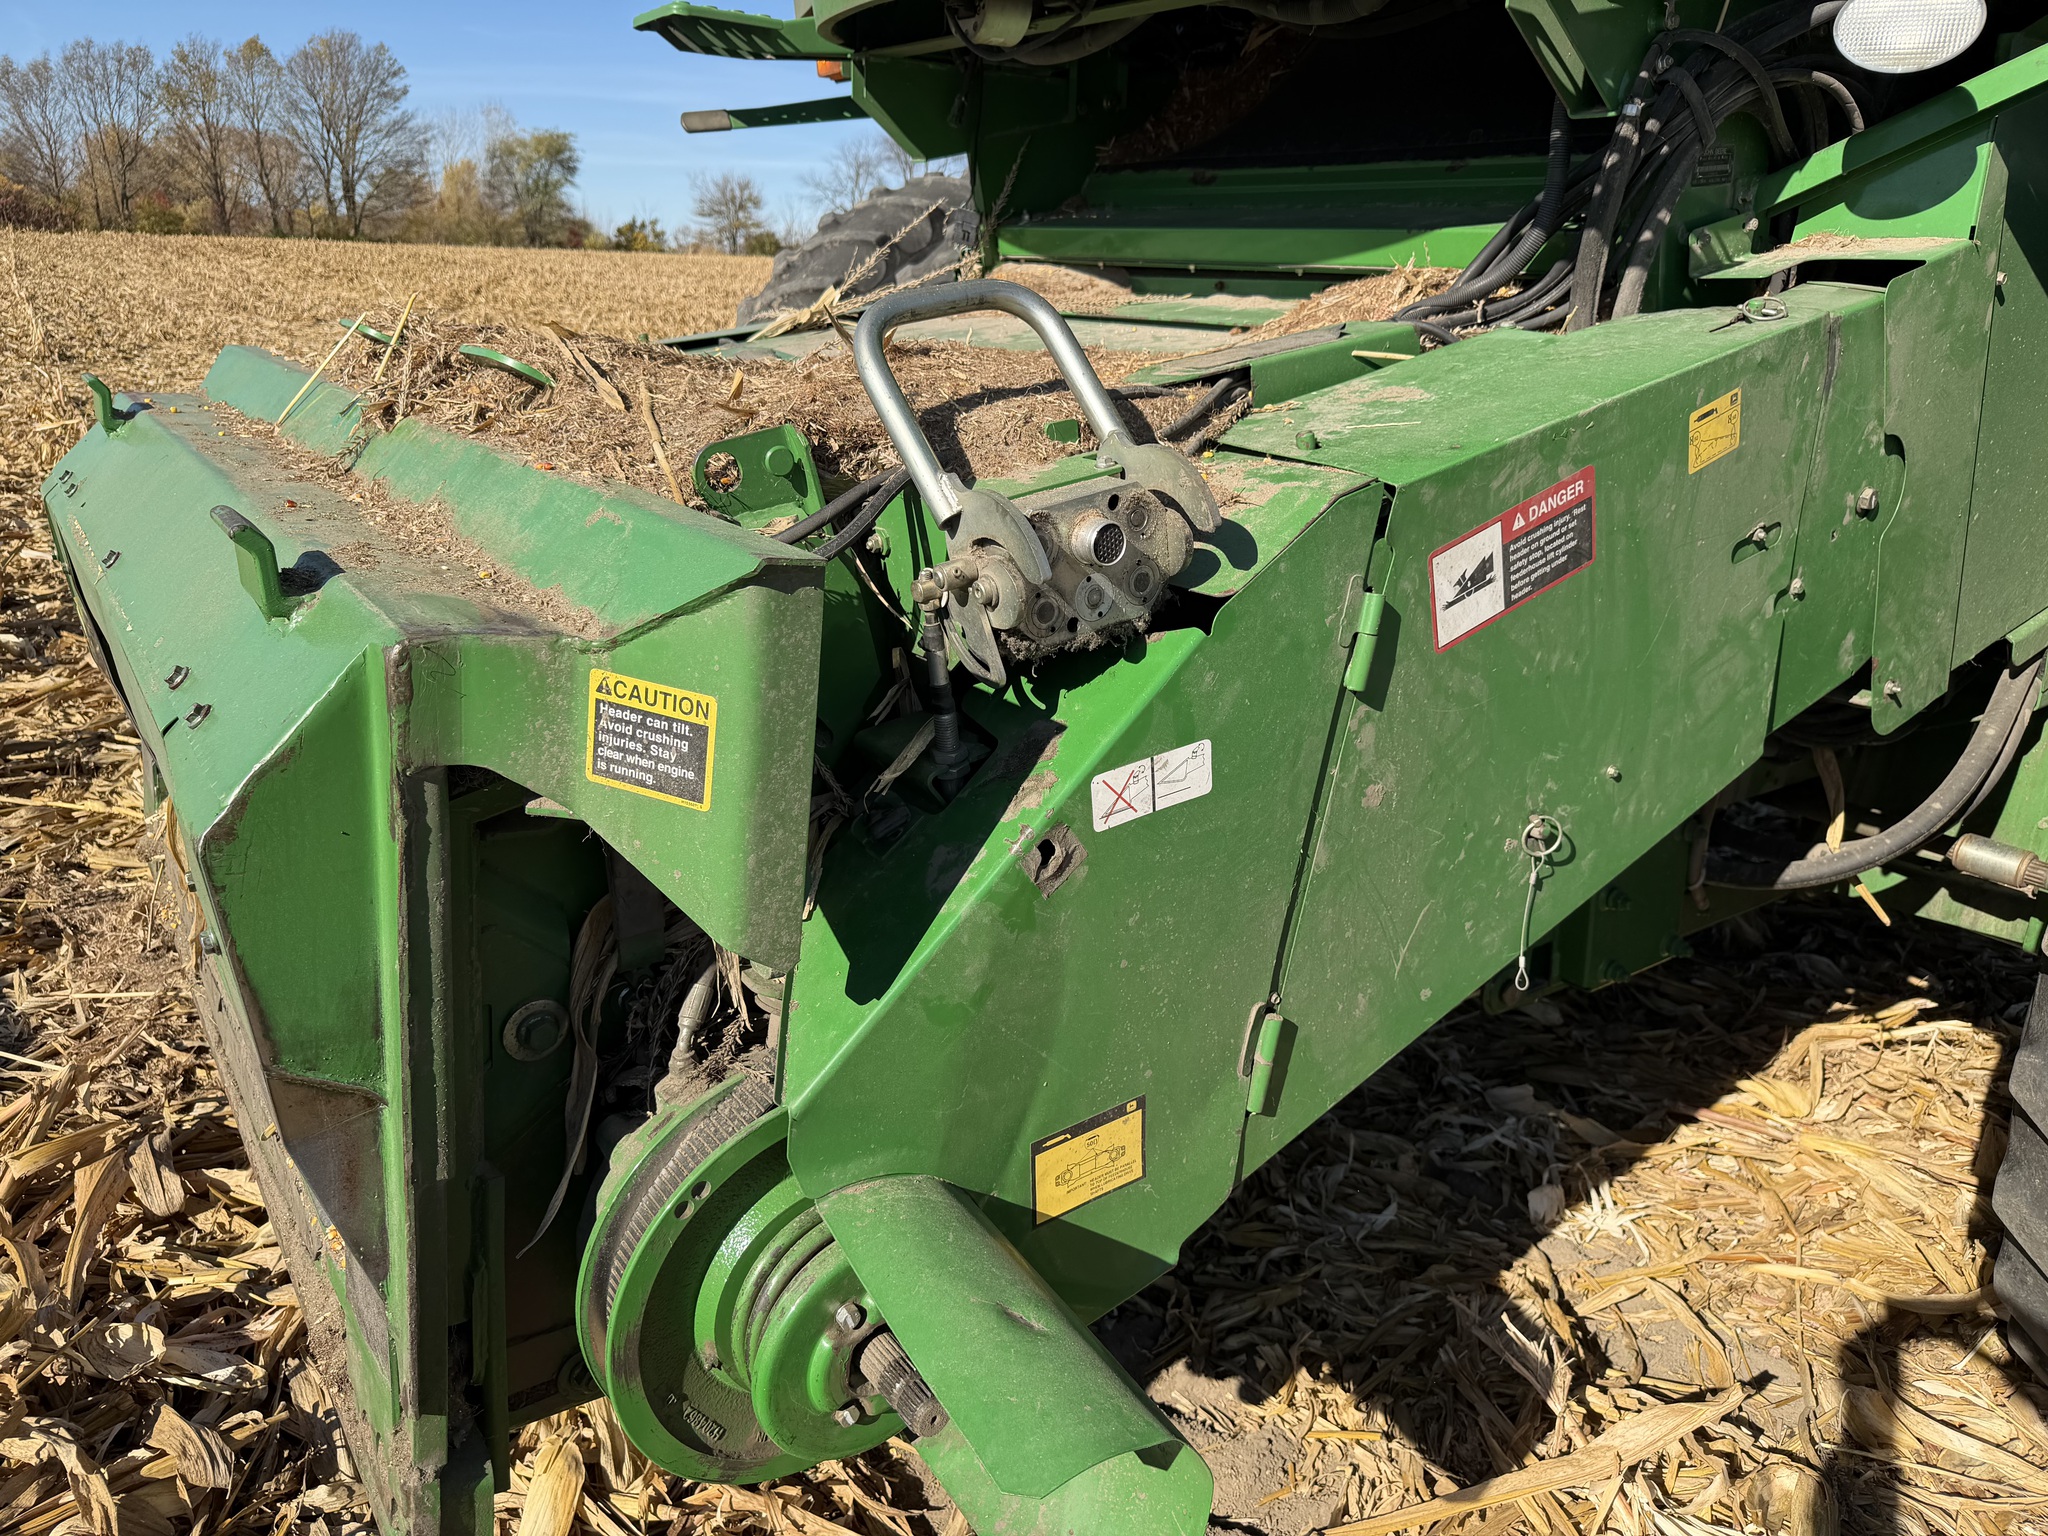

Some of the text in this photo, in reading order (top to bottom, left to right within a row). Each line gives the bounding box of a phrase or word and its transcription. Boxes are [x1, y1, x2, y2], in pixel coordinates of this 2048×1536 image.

[1529, 480, 1584, 522] DANGER
[1510, 537, 1526, 552] Avoid
[1528, 523, 1552, 541] crushing
[1574, 504, 1586, 516] Rest
[1510, 546, 1530, 562] header
[1540, 529, 1560, 546] ground
[1568, 519, 1577, 529] set
[1510, 558, 1528, 572] safety
[1544, 536, 1565, 552] located
[1510, 558, 1546, 582] feederhouse
[1555, 539, 1578, 556] cylinder
[1511, 555, 1568, 591] before getting under
[1511, 585, 1532, 601] header.
[614, 680, 709, 720] CAUTION
[600, 702, 693, 736] Header can tilt.
[600, 720, 689, 752] Avoid crushing
[598, 731, 676, 763] injuries. Stay
[598, 746, 695, 779] clear when engine
[597, 759, 656, 784] is running.
